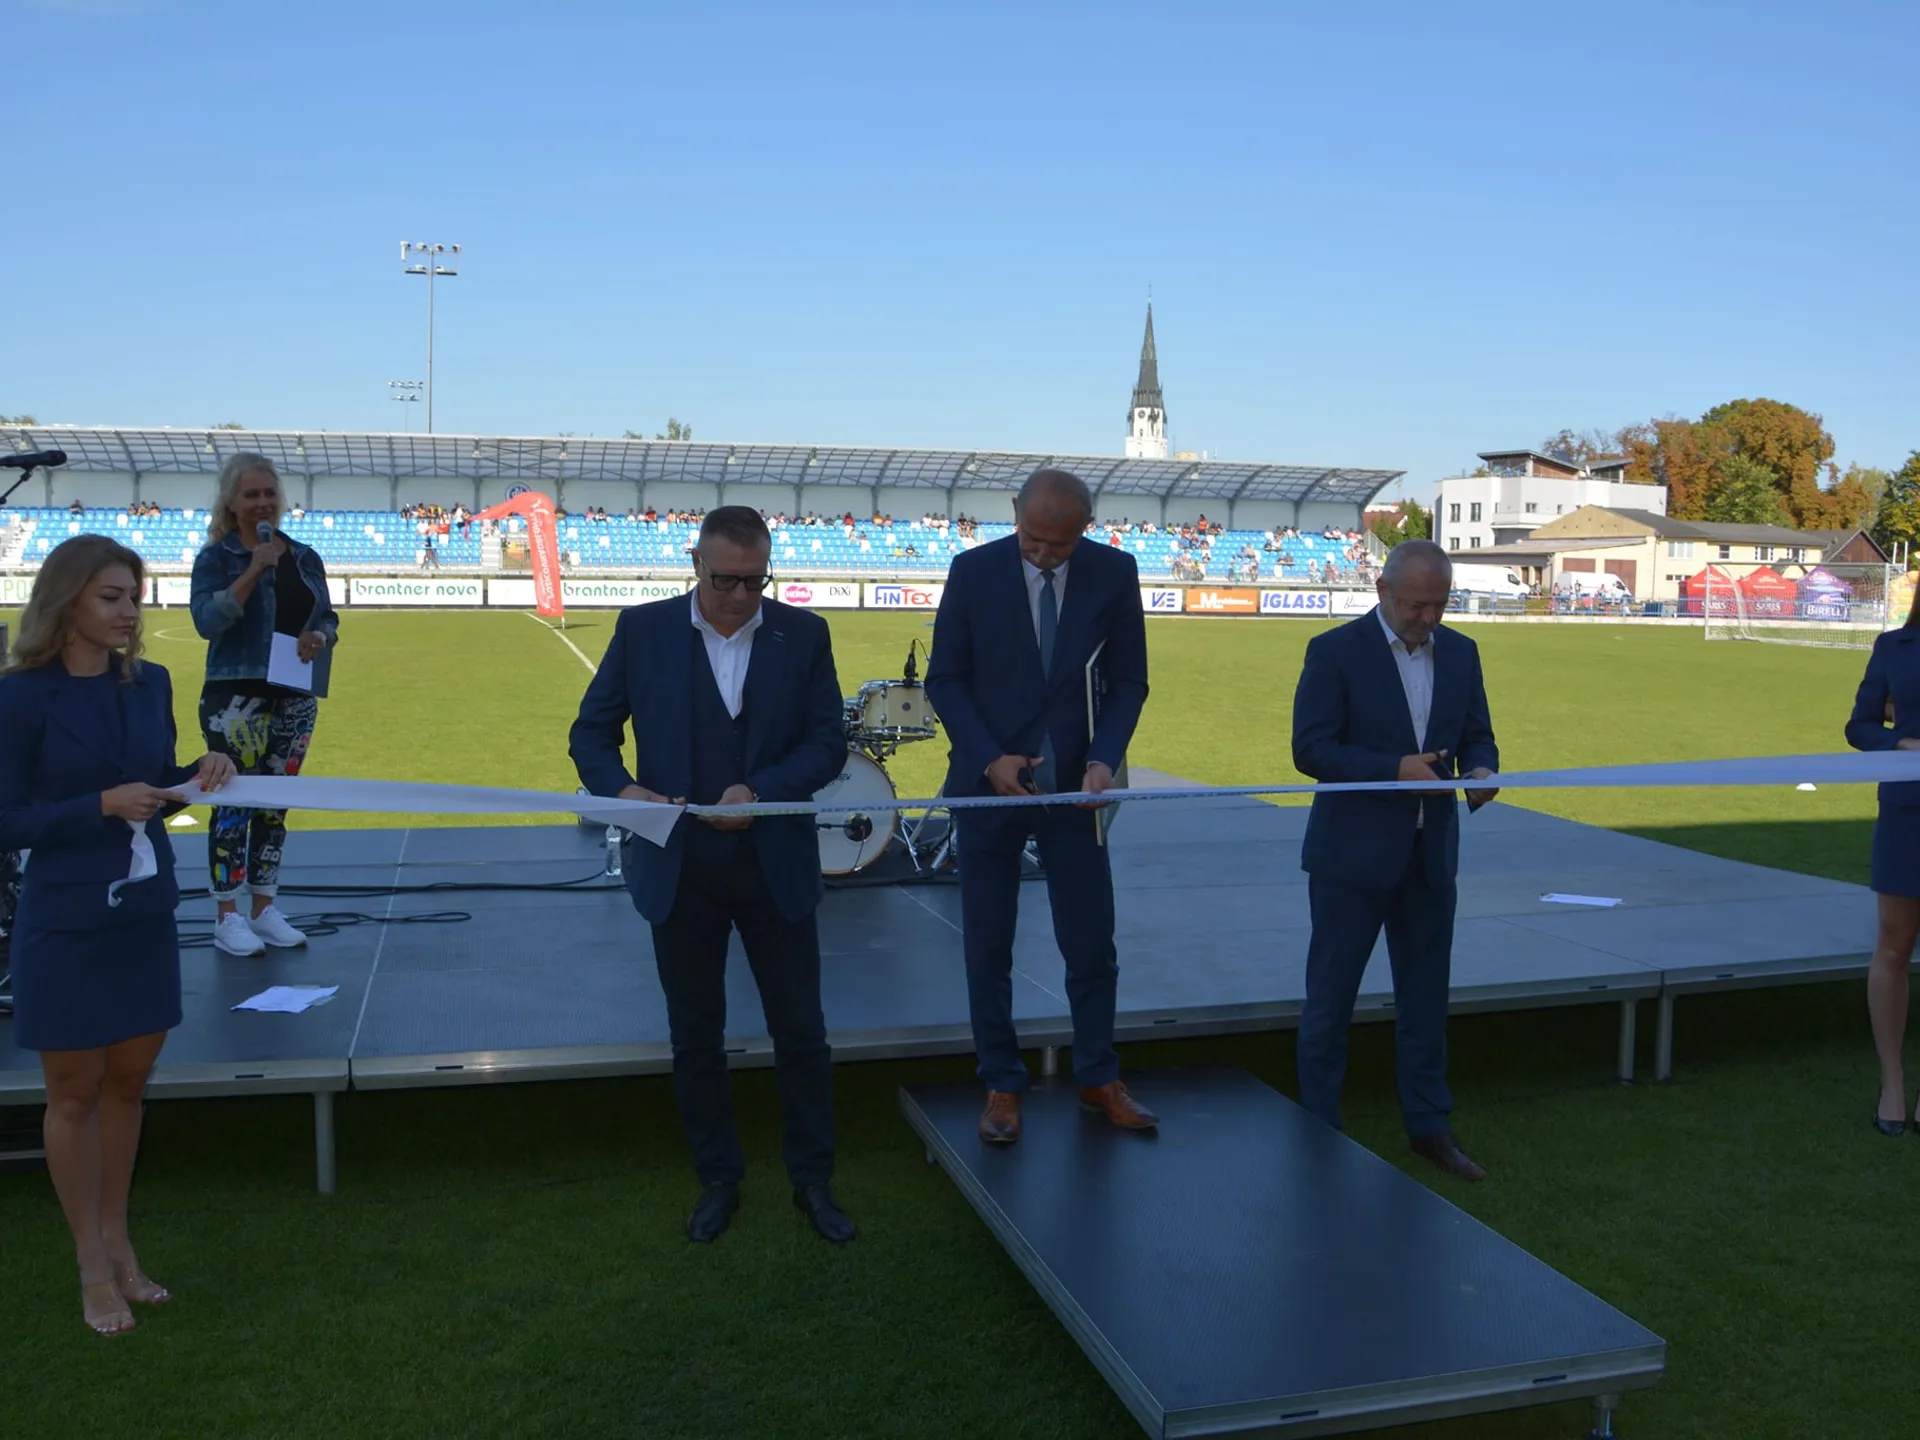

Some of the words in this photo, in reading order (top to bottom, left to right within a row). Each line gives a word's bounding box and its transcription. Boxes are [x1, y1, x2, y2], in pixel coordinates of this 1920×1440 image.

[355, 580, 430, 596] brantner
[436, 585, 477, 596] nova
[563, 582, 636, 597] brantner
[641, 586, 680, 598] nova
[1262, 593, 1327, 609] IGLASS
